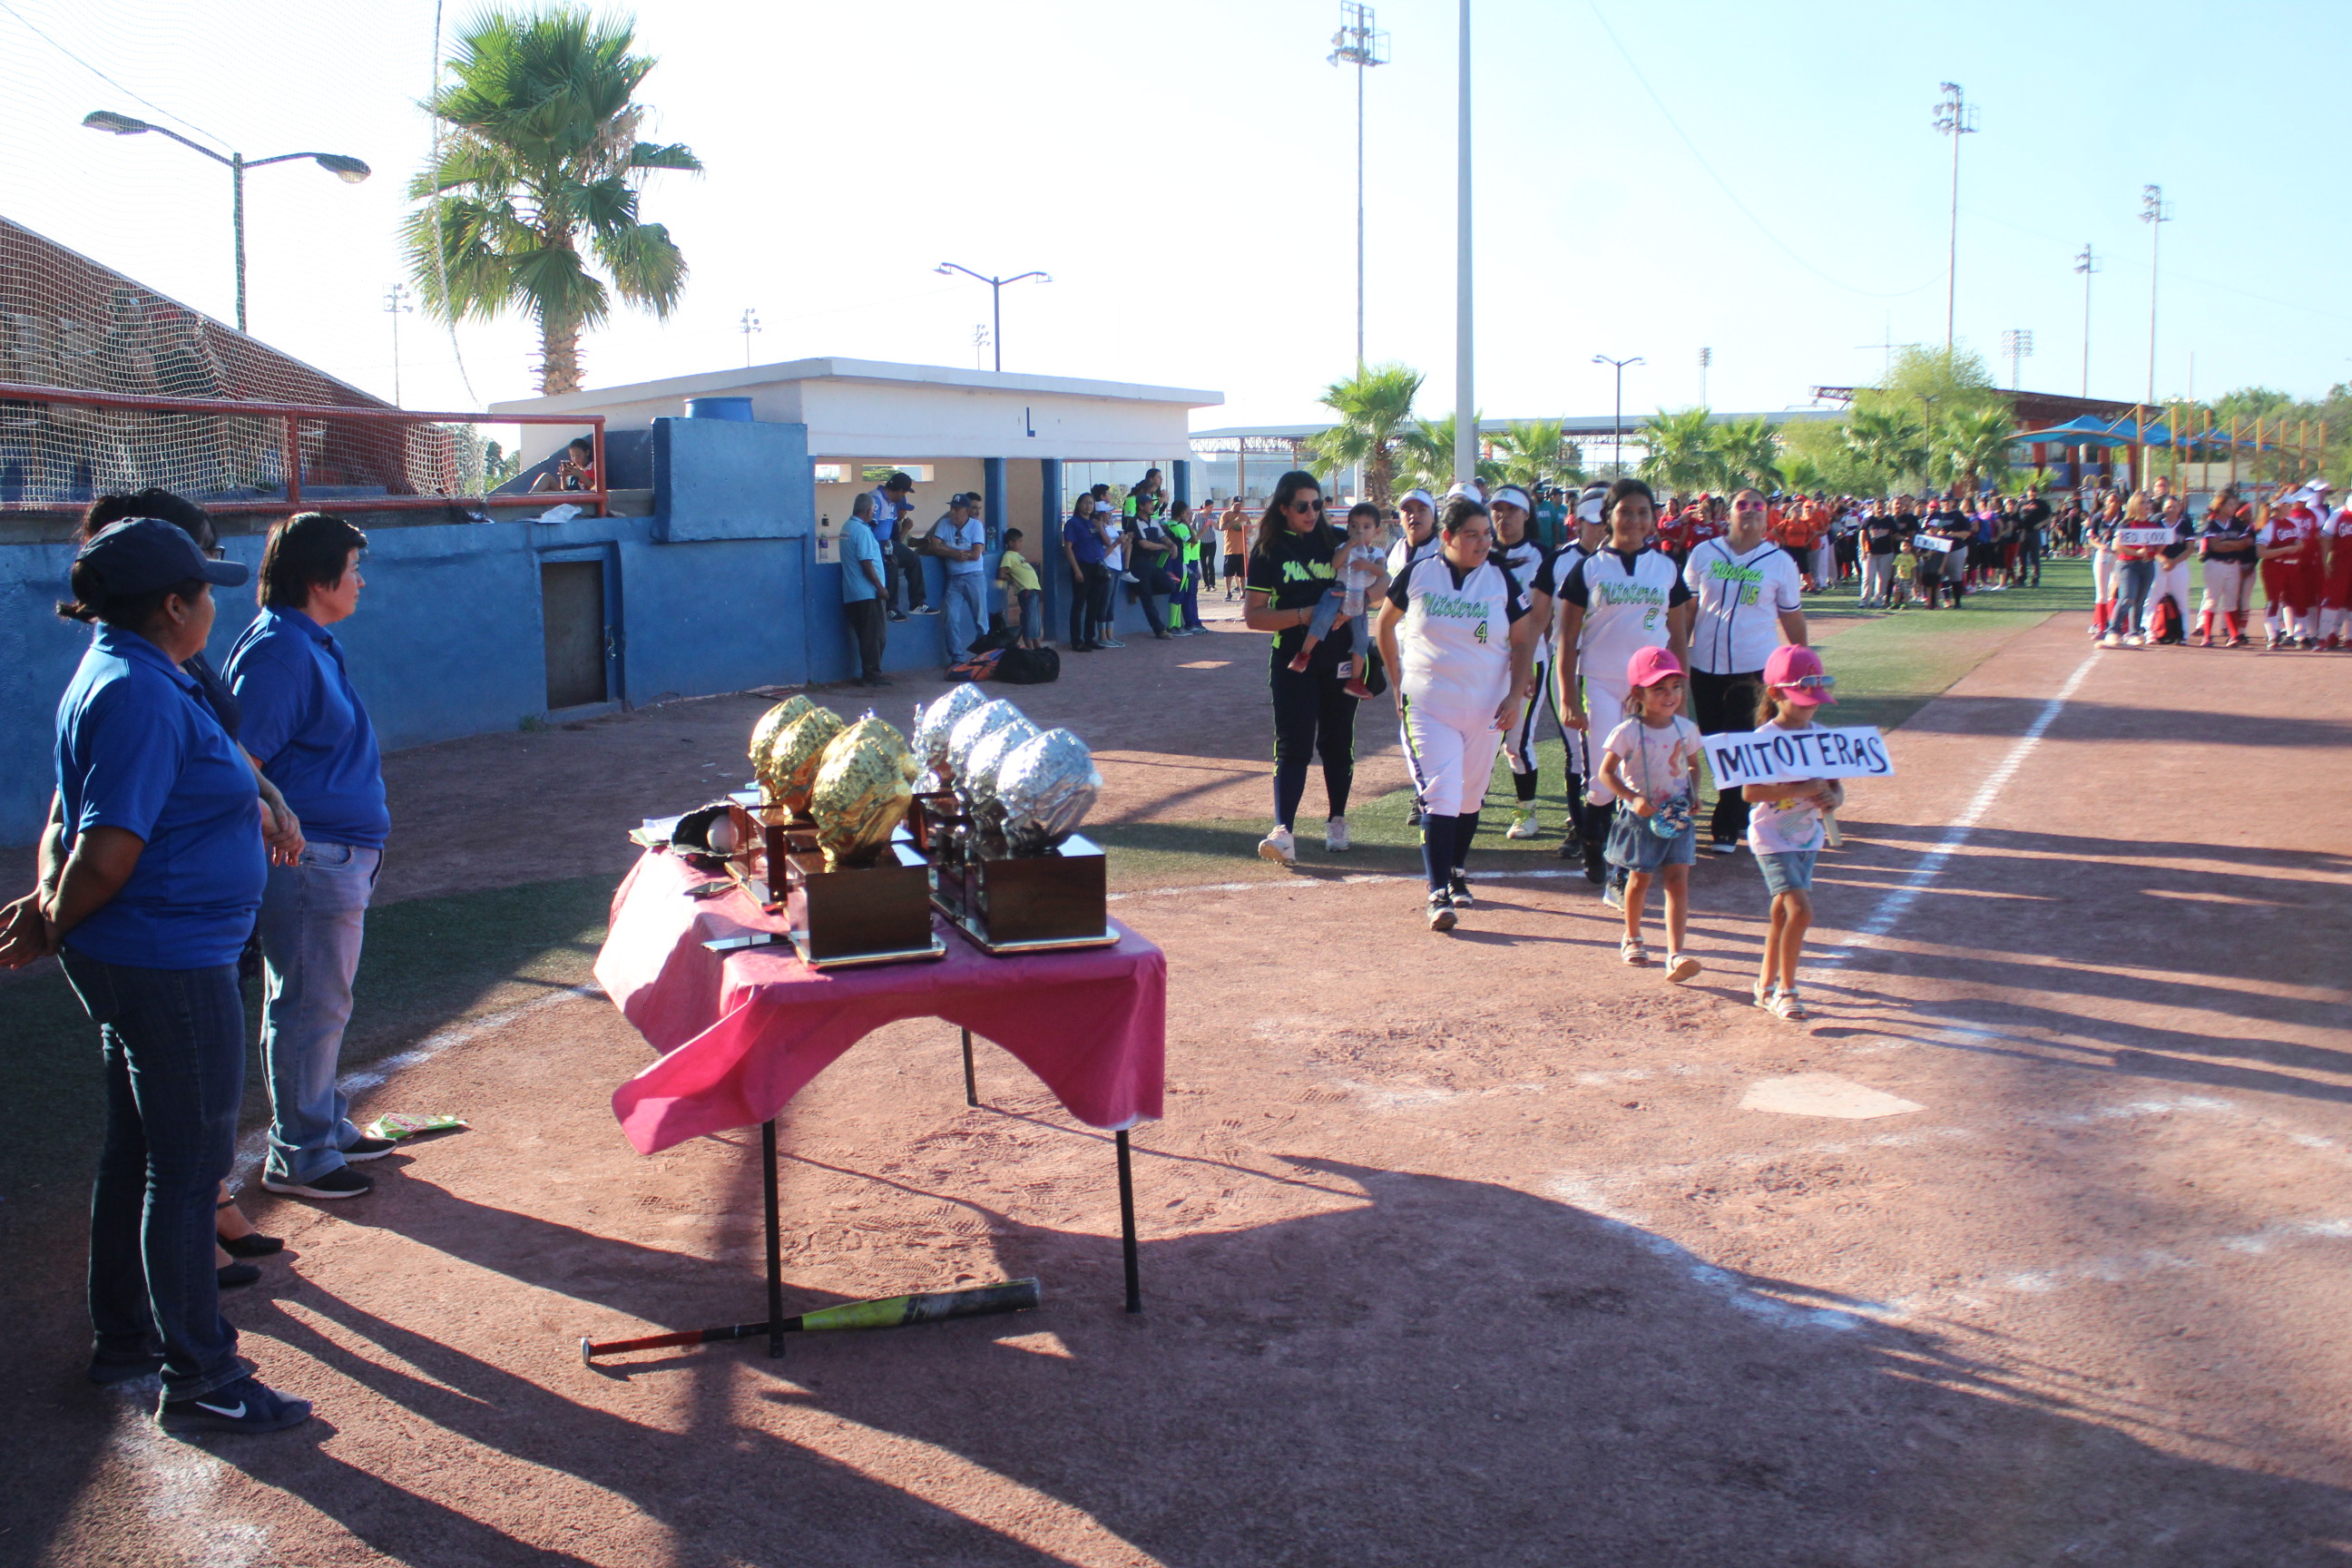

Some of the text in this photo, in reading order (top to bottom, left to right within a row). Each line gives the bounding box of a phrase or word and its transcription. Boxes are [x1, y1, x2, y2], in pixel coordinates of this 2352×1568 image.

[1707, 559, 1764, 583] Mitoteras
[1417, 592, 1490, 619] Mitoteras
[1597, 581, 1665, 607] Mitoteras
[1740, 583, 1760, 606] 15
[1643, 607, 1660, 631] 2
[1475, 620, 1488, 643] 4
[1715, 732, 1888, 782] MITOTERAS
